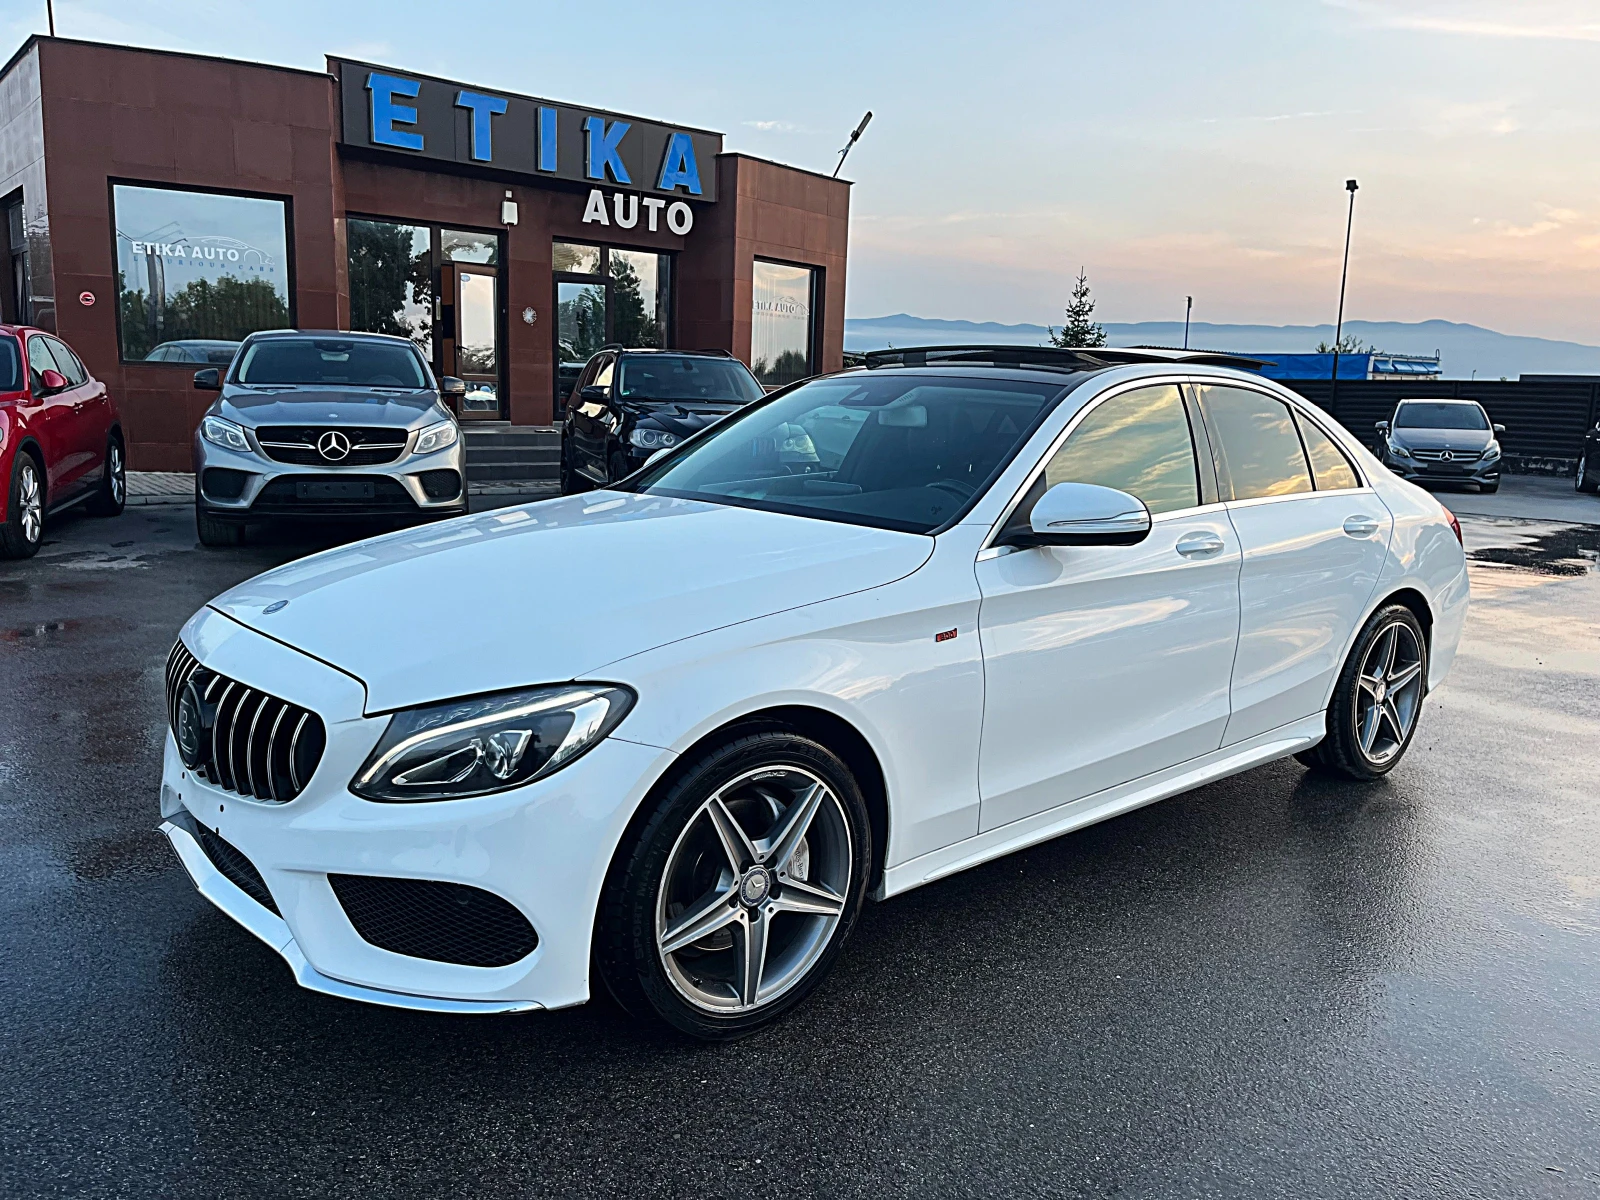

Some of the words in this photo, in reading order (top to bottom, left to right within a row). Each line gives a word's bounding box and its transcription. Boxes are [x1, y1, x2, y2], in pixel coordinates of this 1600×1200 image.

[366, 72, 703, 195] ETIKA
[582, 189, 693, 235] AUTO
[132, 241, 186, 258] ETIKA
[192, 246, 239, 261] AUTO
